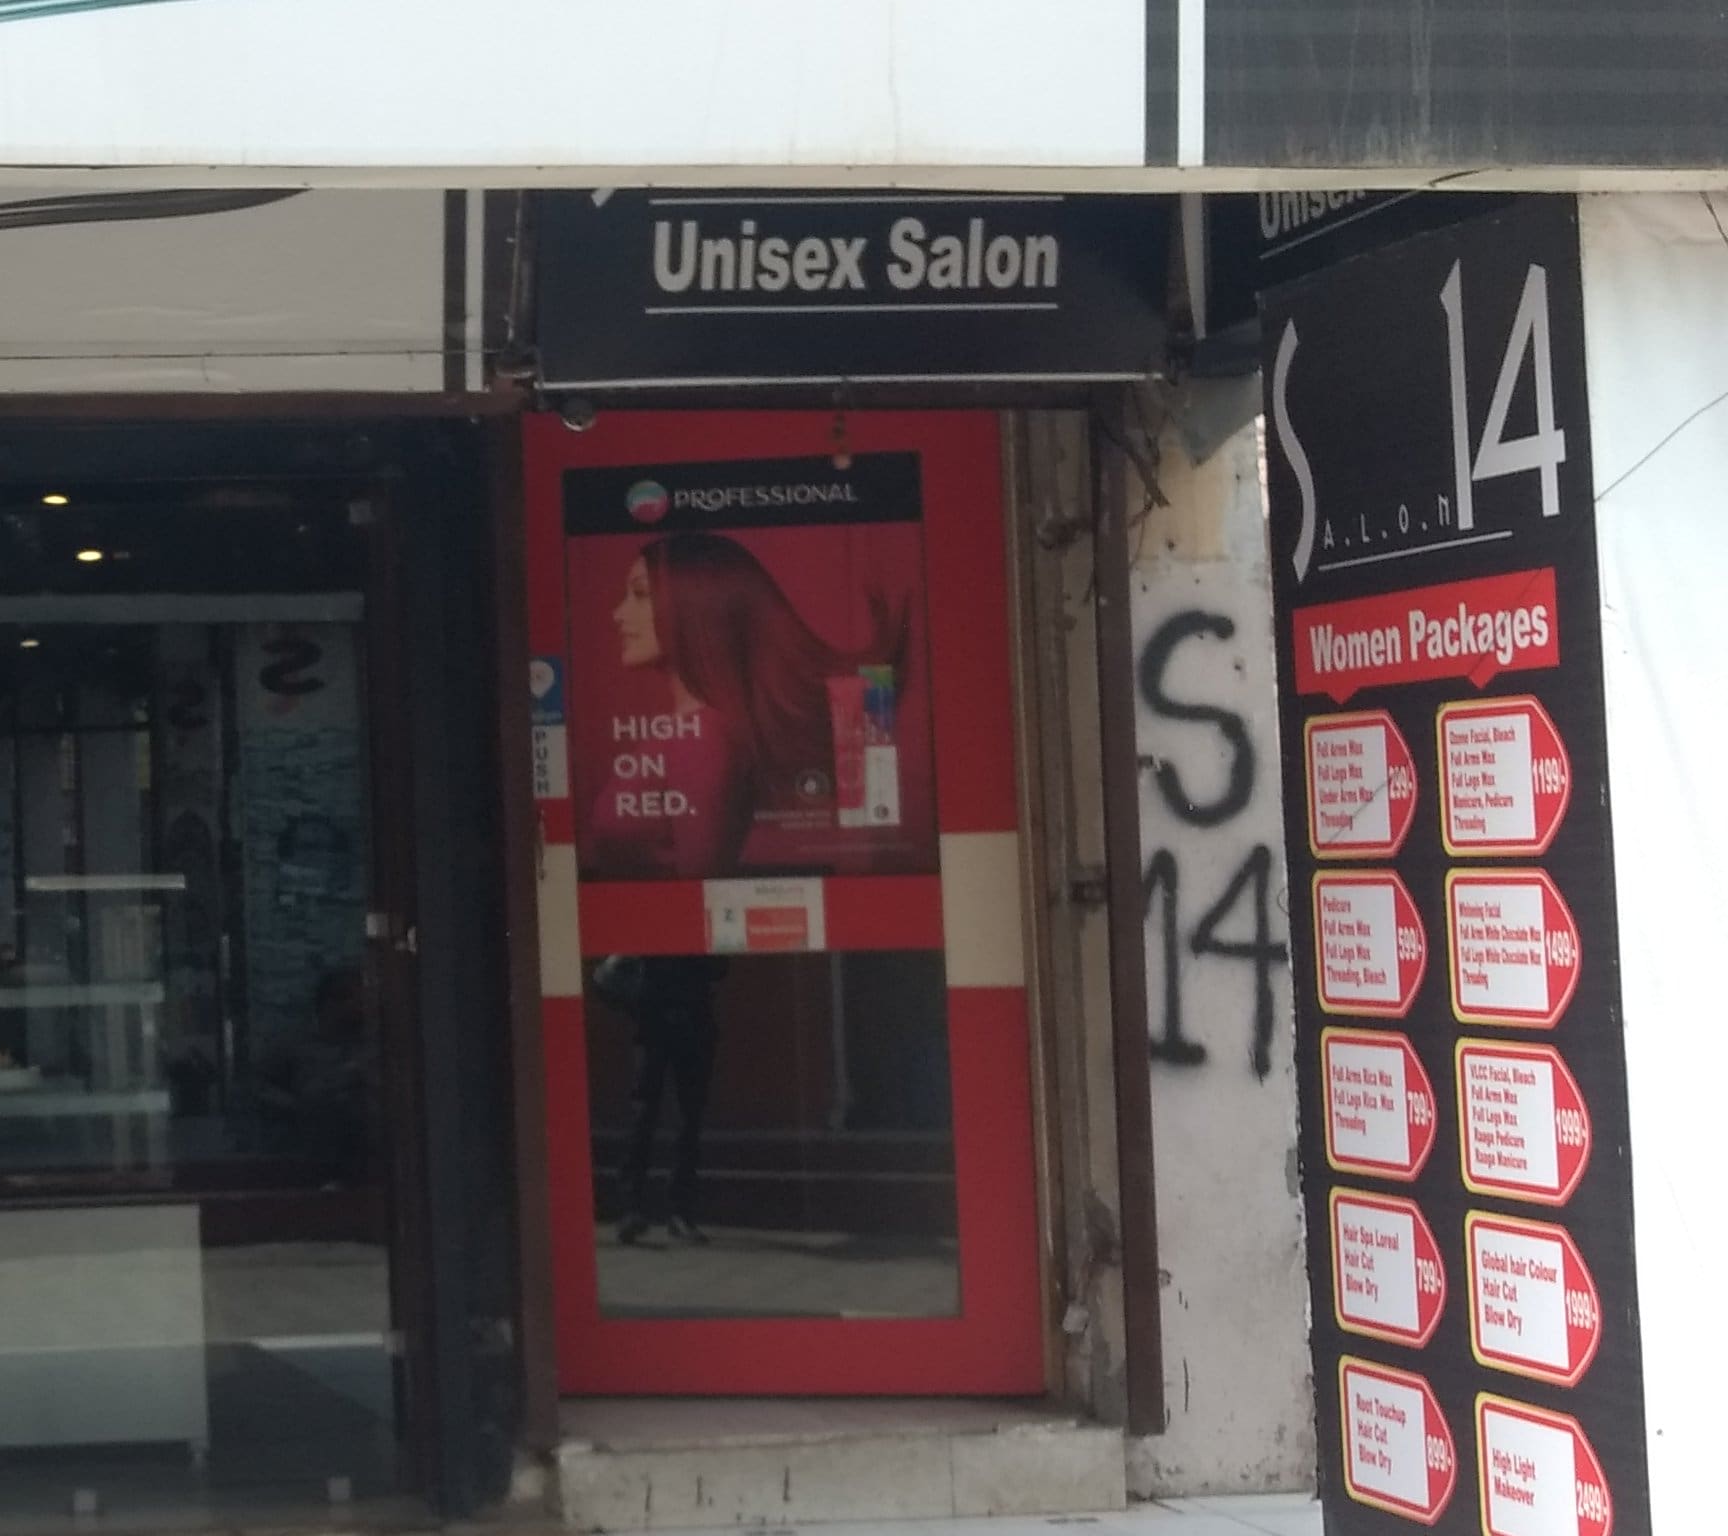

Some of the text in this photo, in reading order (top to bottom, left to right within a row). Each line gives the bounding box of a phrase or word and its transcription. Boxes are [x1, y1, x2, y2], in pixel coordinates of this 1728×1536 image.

[652, 216, 1058, 292] Unisex Salon
[674, 483, 859, 513] PROFESSIONAL
[1310, 601, 1550, 674] Women Packages
[613, 714, 702, 741] HIGH
[1139, 608, 1255, 828] S
[613, 754, 666, 779] ON
[615, 791, 699, 818] RED.
[1142, 843, 1289, 1080] 14
[1480, 1250, 1509, 1273] Global
[1528, 1259, 1559, 1283] Colour
[1482, 1278, 1519, 1303] Hair Cut
[1484, 1304, 1524, 1337] Blow Dry
[1492, 1448, 1537, 1482] High Light
[1494, 1475, 1536, 1506] Makeover
